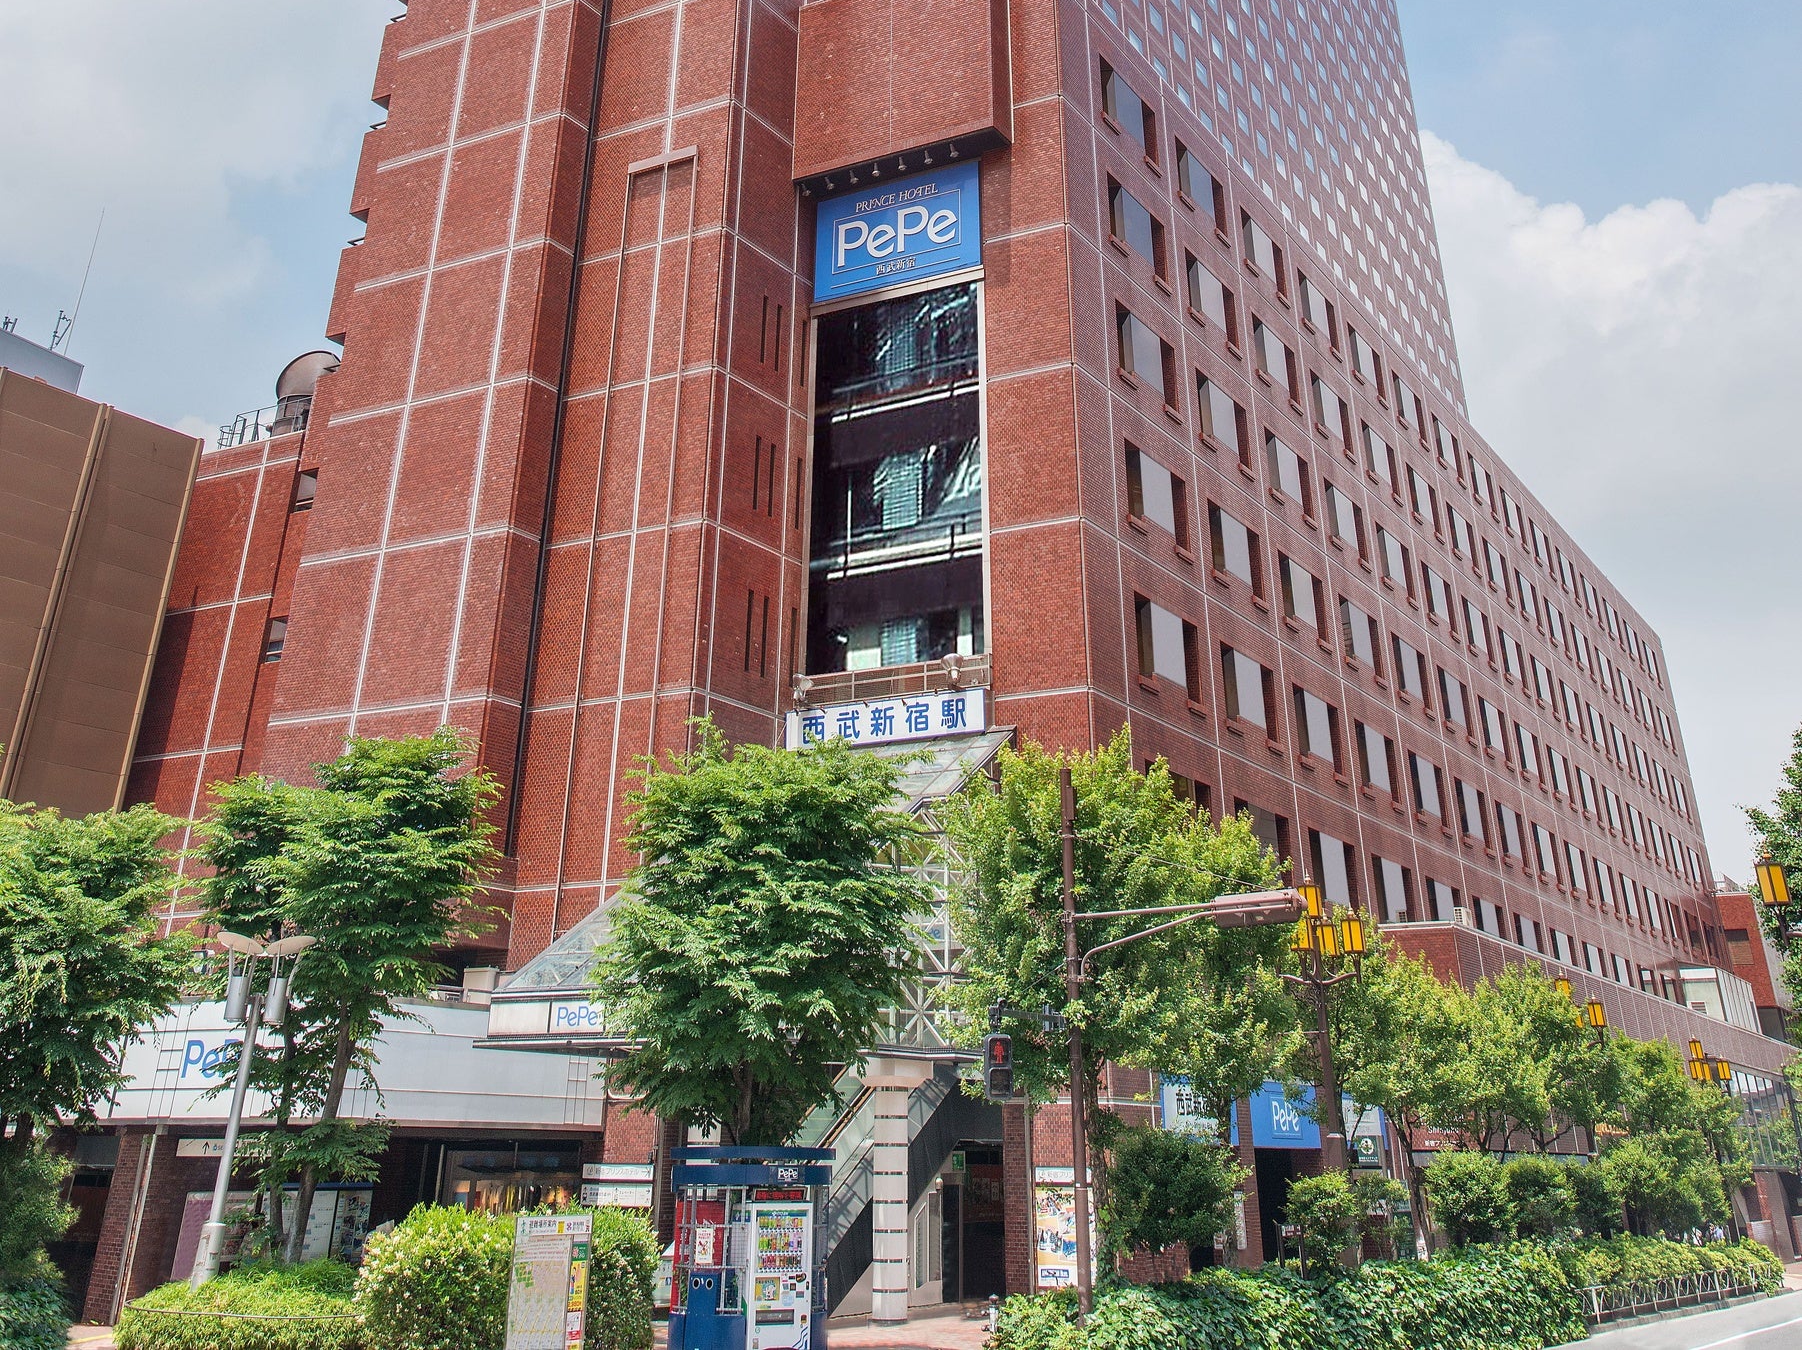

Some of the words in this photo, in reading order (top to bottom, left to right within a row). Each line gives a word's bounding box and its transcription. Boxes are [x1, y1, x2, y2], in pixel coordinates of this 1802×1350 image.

[855, 193, 895, 213] PRINCE
[899, 183, 938, 201] HOTEL
[837, 205, 958, 268] PePe
[876, 257, 916, 275] 西武新宿
[802, 697, 967, 745] 西武新宿駅
[556, 1006, 598, 1027] PePe
[1272, 1100, 1300, 1132] PePe
[778, 1168, 798, 1178] PePe
